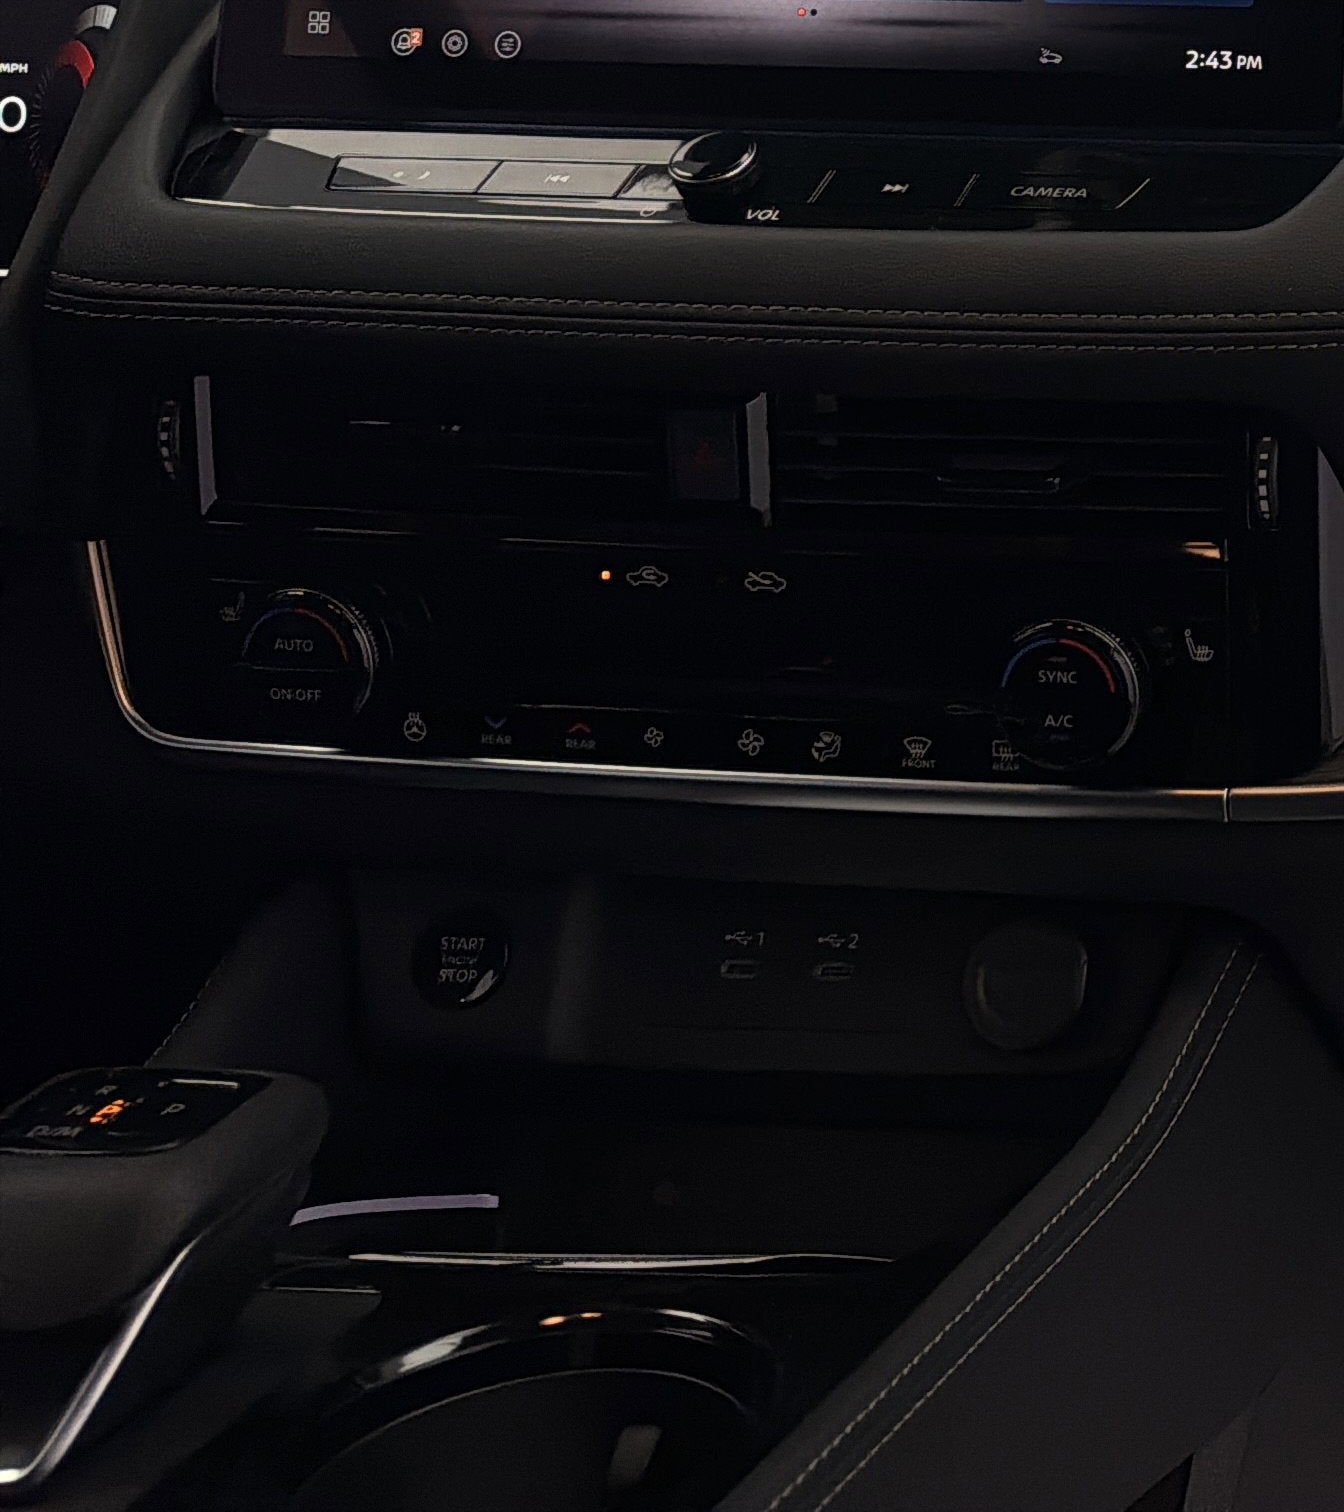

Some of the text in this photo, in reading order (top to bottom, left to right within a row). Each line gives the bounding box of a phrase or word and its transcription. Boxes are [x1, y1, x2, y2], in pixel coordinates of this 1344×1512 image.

[1185, 50, 1263, 70] 2:43 PM
[1010, 184, 1088, 199] CAMERA
[745, 208, 781, 221] VOL
[273, 638, 314, 653] AUTO
[1037, 669, 1078, 685] SYNC
[1044, 714, 1074, 729] A/C
[439, 937, 487, 951] START
[756, 932, 765, 947] 1
[847, 934, 859, 949] 2
[159, 1102, 186, 1116] P
